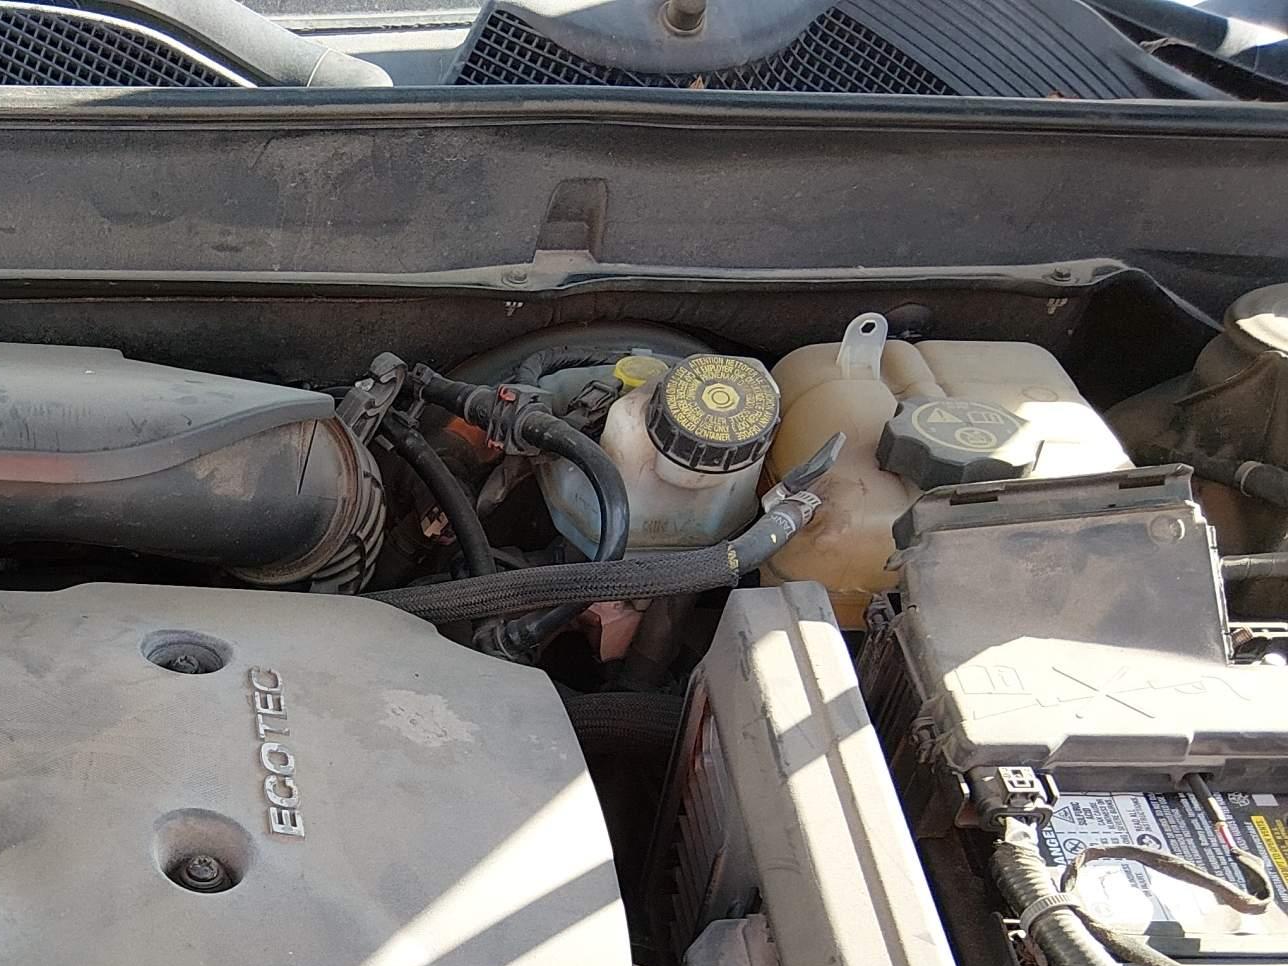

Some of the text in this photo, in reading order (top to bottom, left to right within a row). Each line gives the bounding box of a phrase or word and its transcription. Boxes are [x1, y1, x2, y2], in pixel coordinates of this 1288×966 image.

[248, 665, 306, 840] ECOTEC
[1070, 802, 1087, 826] SULFURIC
[1083, 807, 1094, 819] ACID
[1132, 819, 1144, 832] READ
